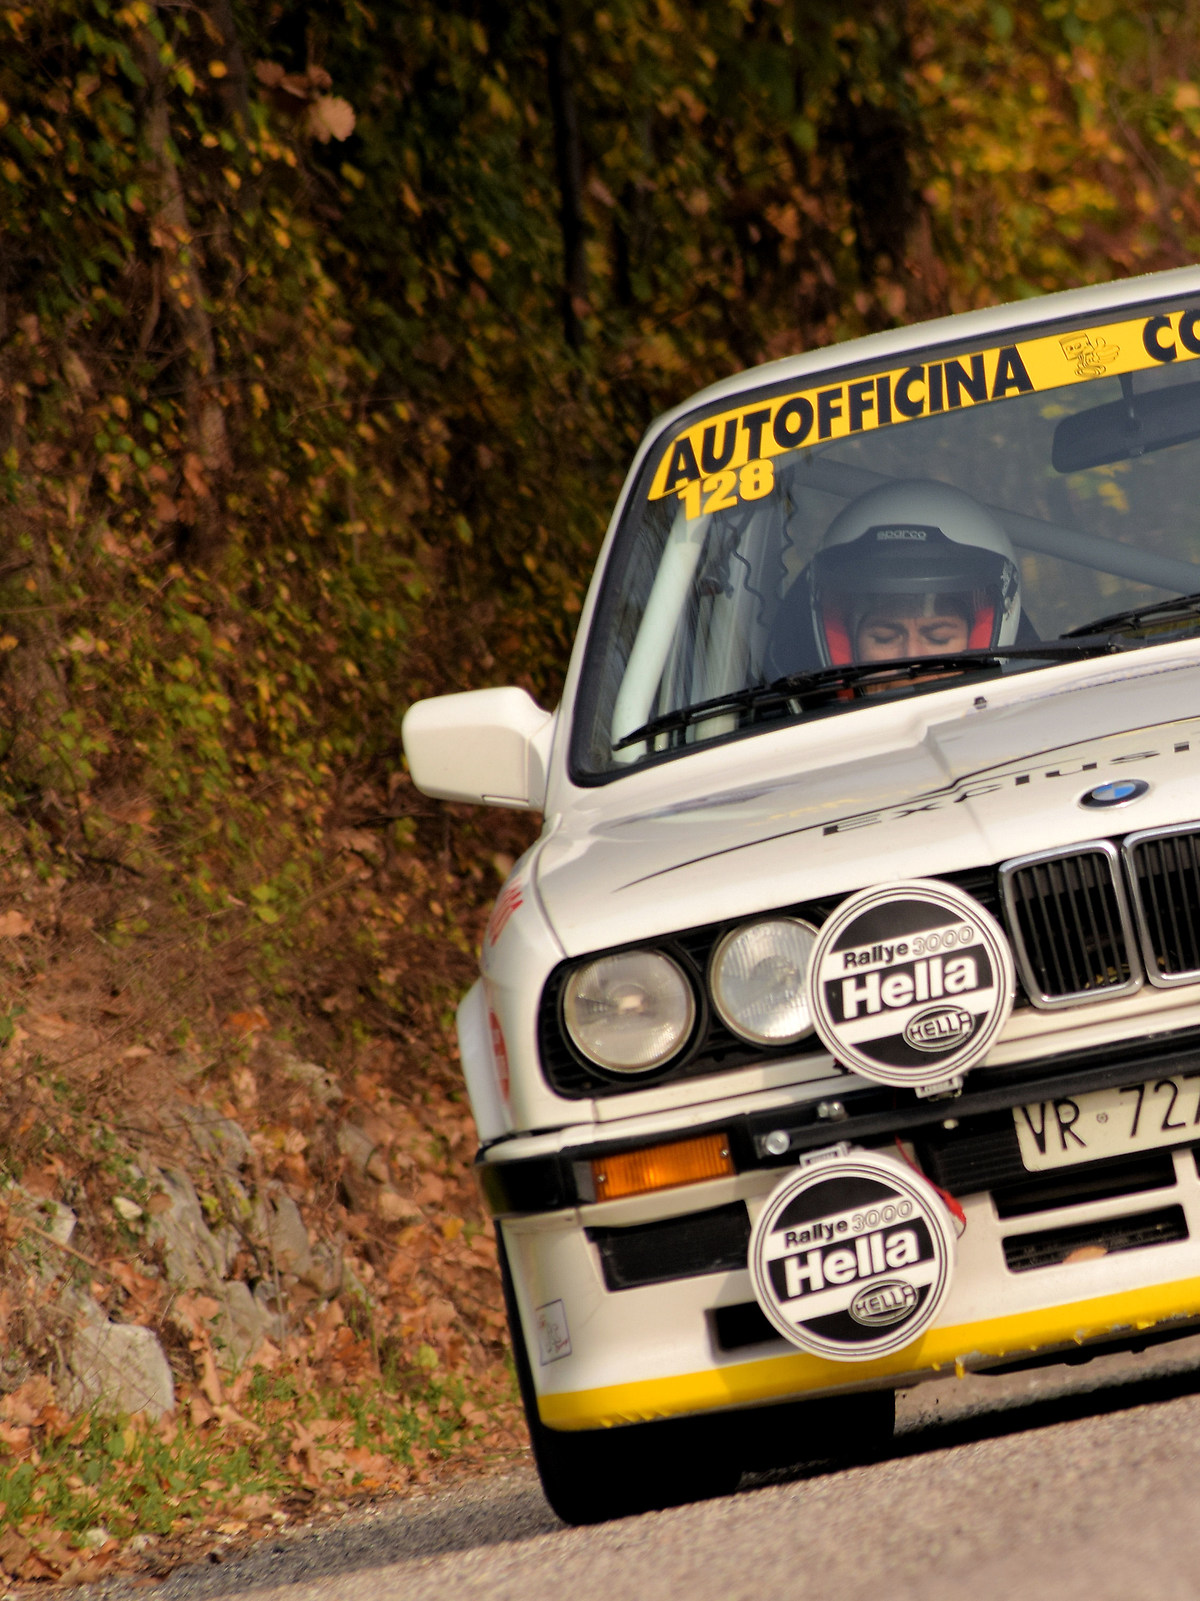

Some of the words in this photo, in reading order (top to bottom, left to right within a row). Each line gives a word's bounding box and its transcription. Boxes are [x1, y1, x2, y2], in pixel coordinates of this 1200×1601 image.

[664, 344, 1034, 493] AUTOFFICINA
[678, 459, 775, 520] 128
[843, 943, 909, 970] Rallye
[912, 925, 974, 956] 3000
[841, 955, 978, 1019] Hella
[909, 1010, 973, 1041] HELLA
[1022, 1097, 1087, 1154] VR
[784, 1218, 848, 1249] Rallye
[852, 1200, 913, 1232] 3000
[784, 1229, 919, 1298] Hella
[855, 1284, 916, 1317] HELLA
